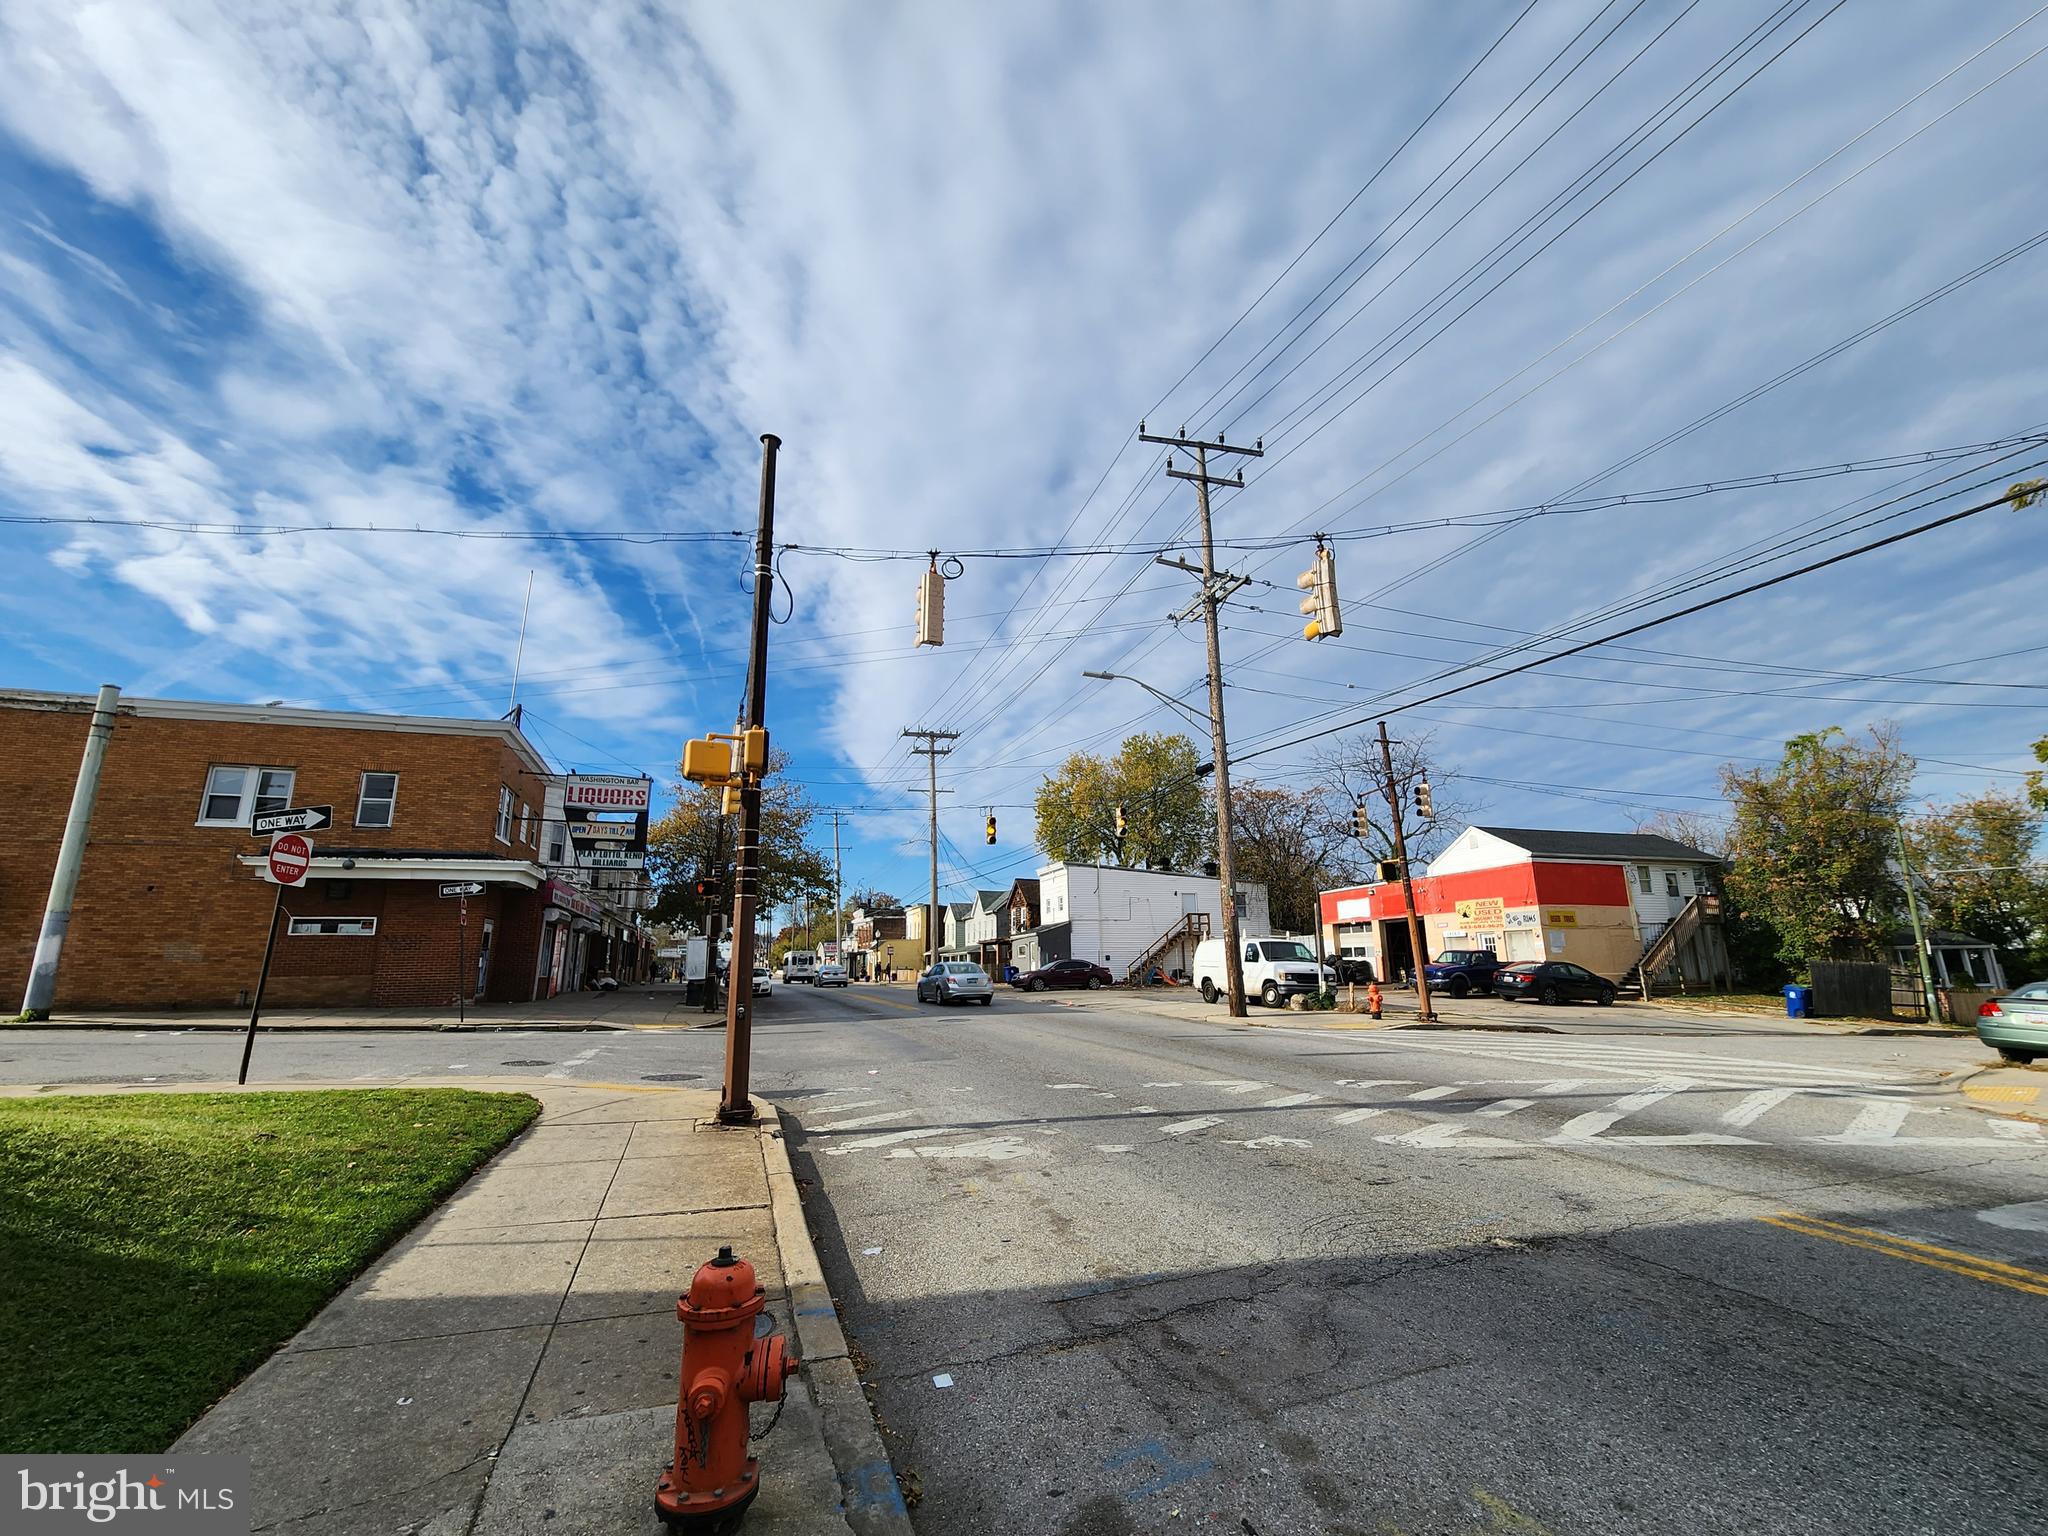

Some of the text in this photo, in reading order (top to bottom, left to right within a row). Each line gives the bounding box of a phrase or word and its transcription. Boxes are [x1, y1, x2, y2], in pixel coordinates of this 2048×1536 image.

[579, 776, 625, 785] WASHINGTON
[567, 786, 646, 805] LIQUORS
[260, 815, 307, 829] ONE WAY
[572, 824, 635, 837] OPEN 7 DAYS TILL 2 AM
[278, 842, 306, 855] DO NOT
[578, 850, 597, 858] PLAY
[624, 852, 642, 860] KENO
[592, 859, 628, 867] BILLIARDS
[276, 864, 299, 875] ENTER
[1522, 914, 1536, 922] RIMS
